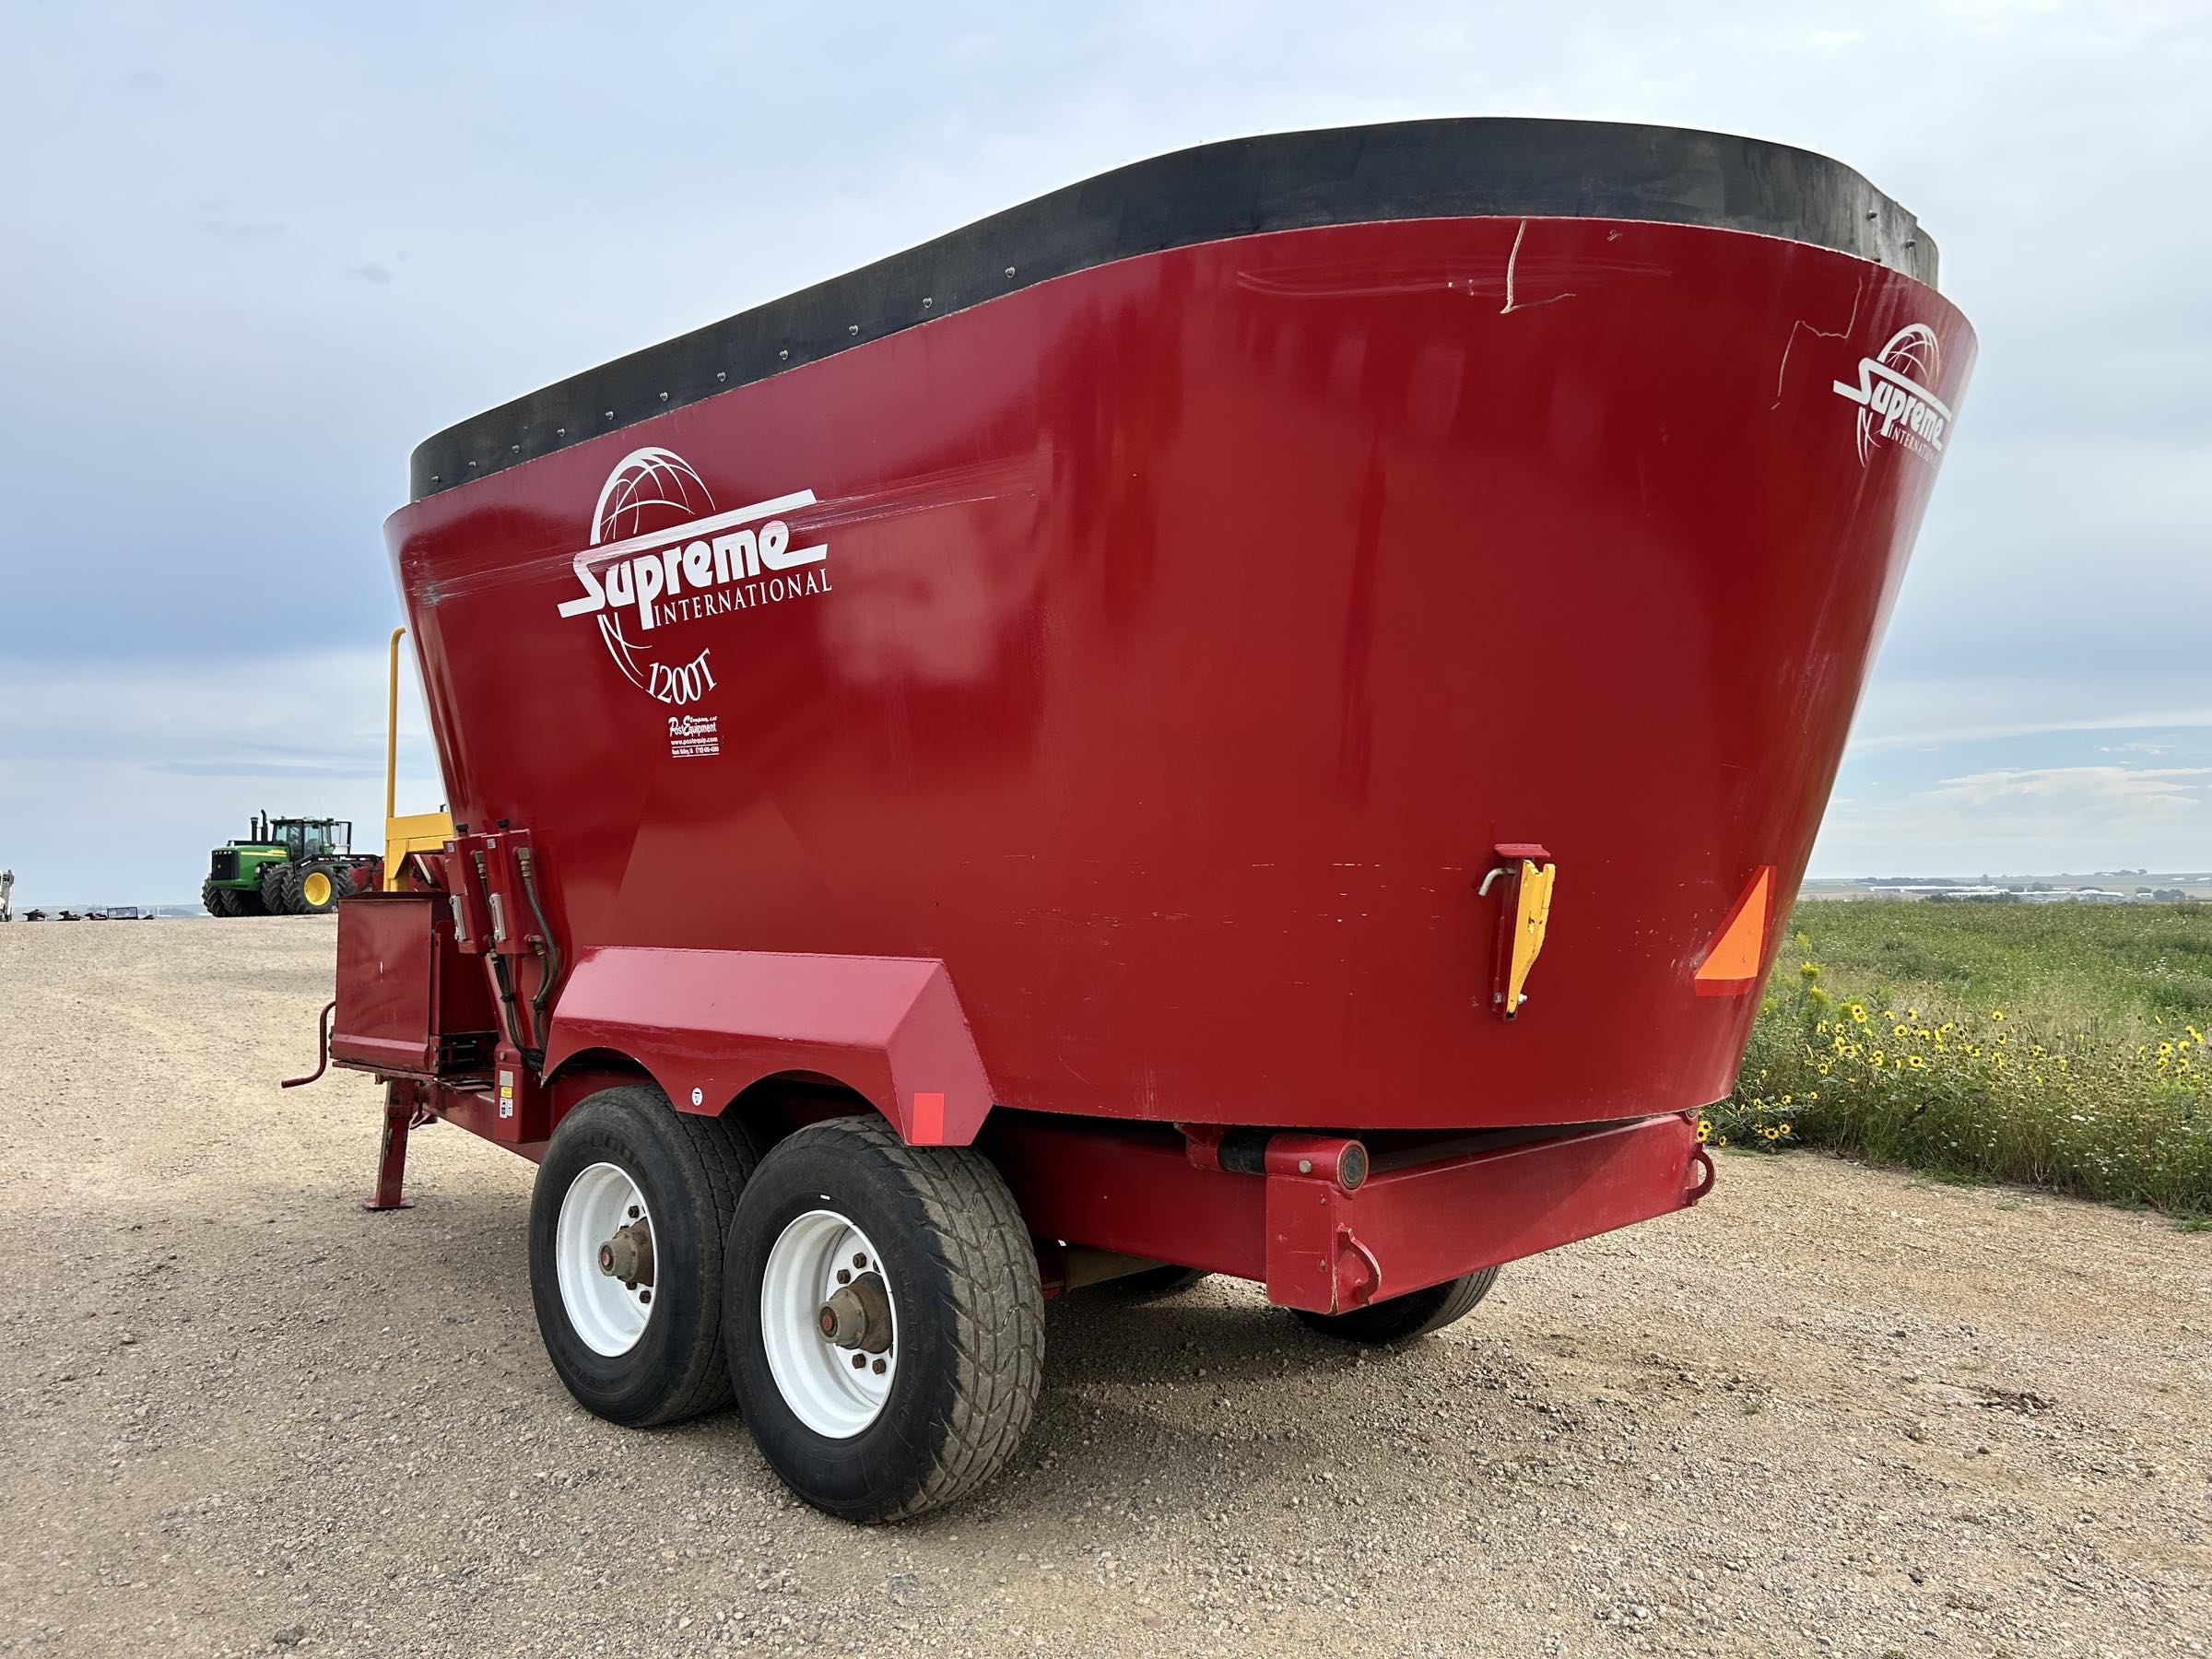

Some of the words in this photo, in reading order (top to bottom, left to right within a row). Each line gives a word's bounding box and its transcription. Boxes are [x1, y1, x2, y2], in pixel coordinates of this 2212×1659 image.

[1833, 357, 1952, 453] Supreme
[1887, 424, 1939, 468] INTERNATIO
[557, 488, 829, 630] Supreme
[654, 568, 833, 627] INTERNATIONAL
[646, 648, 717, 706] 1200T
